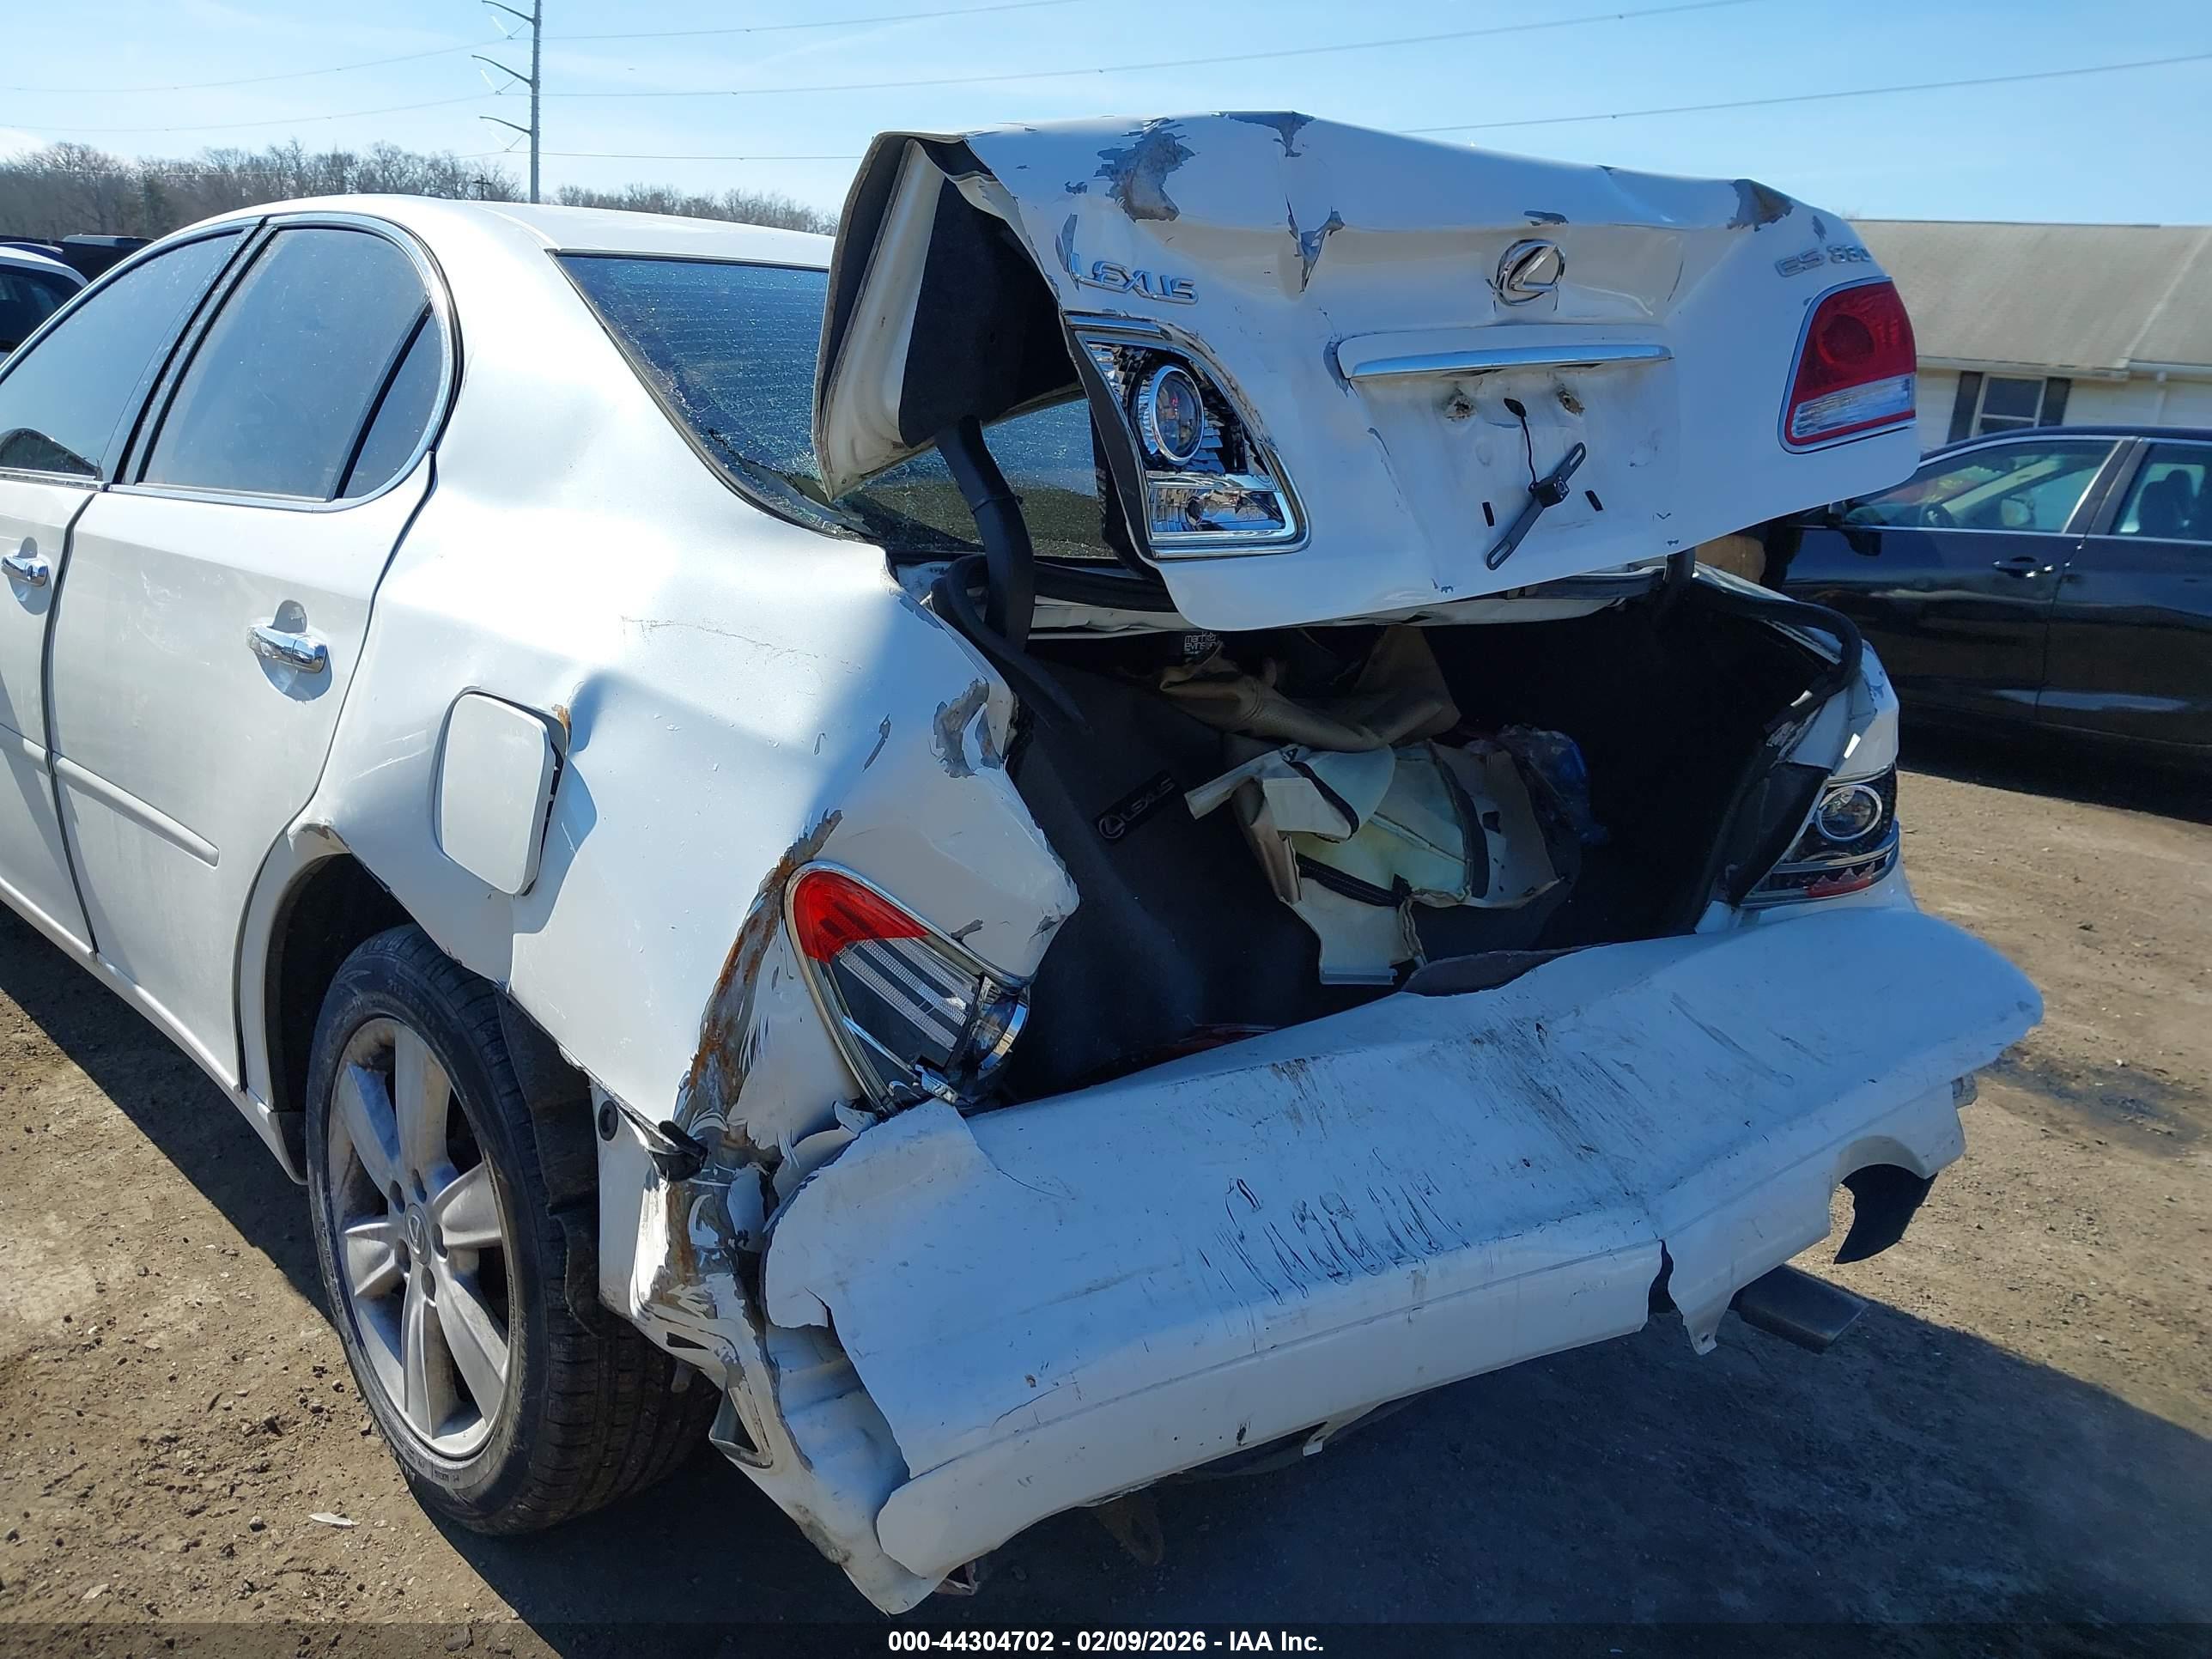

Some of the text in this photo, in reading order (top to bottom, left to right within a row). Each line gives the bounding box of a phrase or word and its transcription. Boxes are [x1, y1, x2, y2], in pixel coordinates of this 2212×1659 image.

[1067, 252, 1200, 305] LEXUS
[1774, 248, 1825, 277] ES
[1120, 777, 1176, 822] LEXUS
